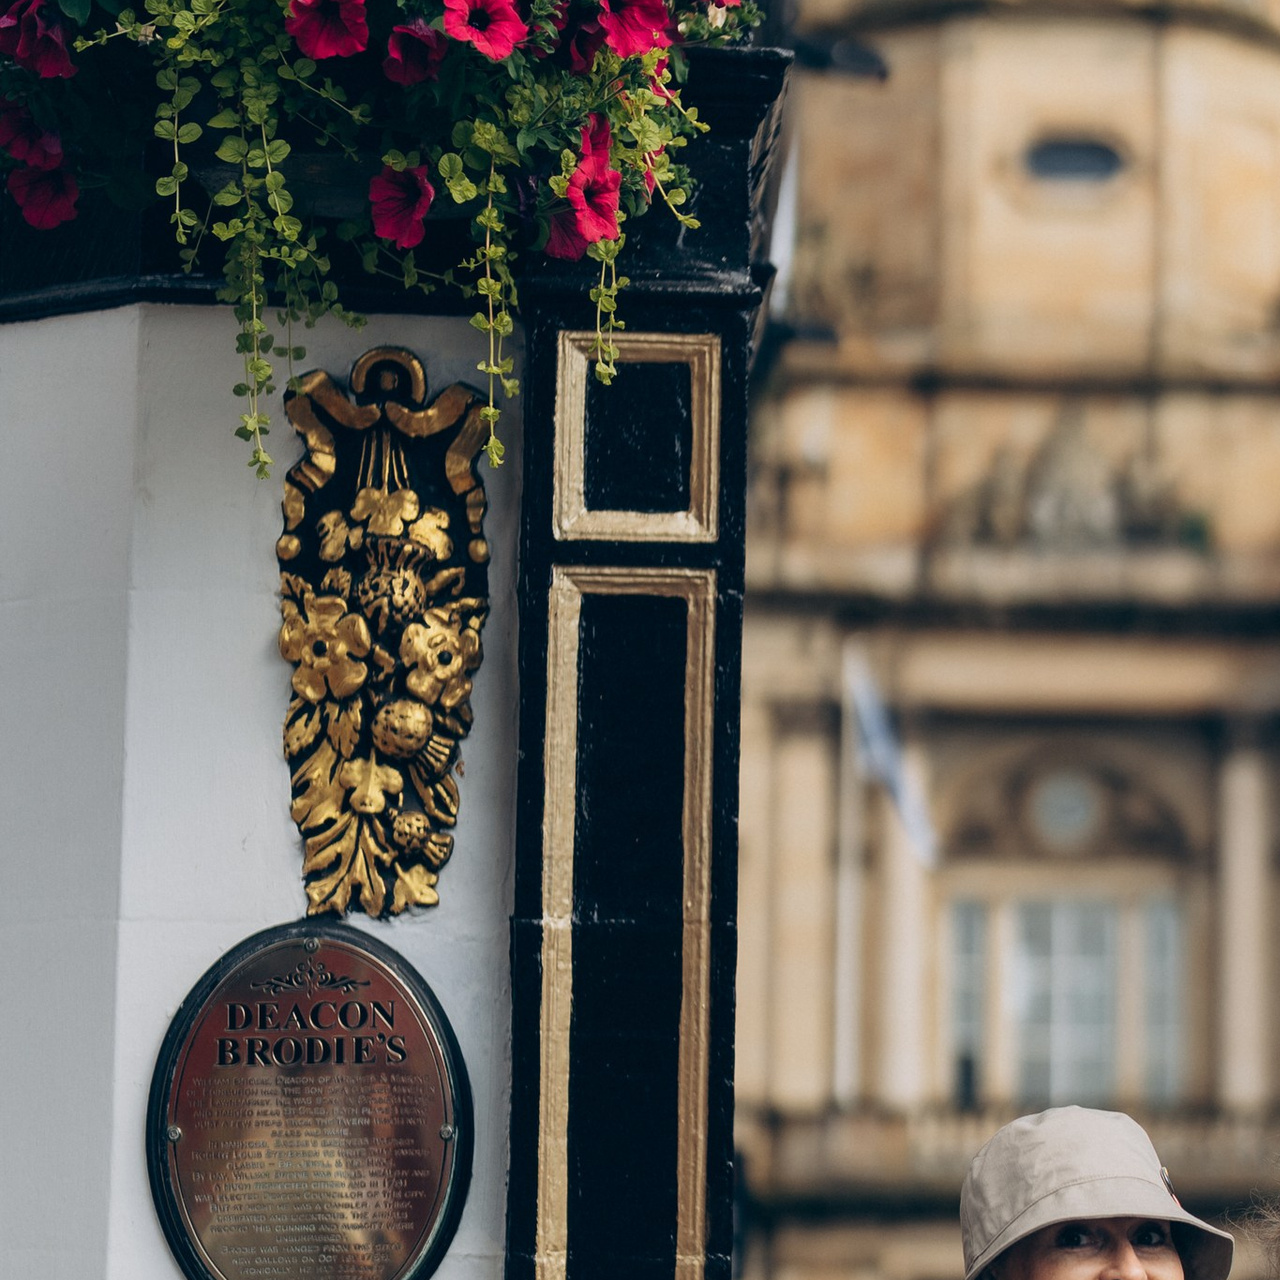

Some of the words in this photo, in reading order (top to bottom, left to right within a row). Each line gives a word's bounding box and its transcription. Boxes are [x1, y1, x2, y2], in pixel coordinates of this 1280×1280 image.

[225, 1001, 396, 1032] DEACON
[216, 1036, 408, 1067] BRODIE'S
[275, 1075, 314, 1085] DEACON
[281, 1085, 300, 1095] THE
[304, 1085, 323, 1095] SON
[338, 1117, 370, 1126] TAVERN
[232, 1150, 263, 1159] LOUIS
[347, 1179, 366, 1189] AND
[217, 1192, 259, 1202] ELECTED
[303, 1190, 363, 1200] COUNCILLOR
[293, 1200, 311, 1211] WAS
[351, 1211, 369, 1220] THE
[274, 1223, 316, 1232] CUNNING
[319, 1222, 337, 1231] AND
[260, 1245, 279, 1253] WAS
[255, 1255, 298, 1263] GALLOWS
